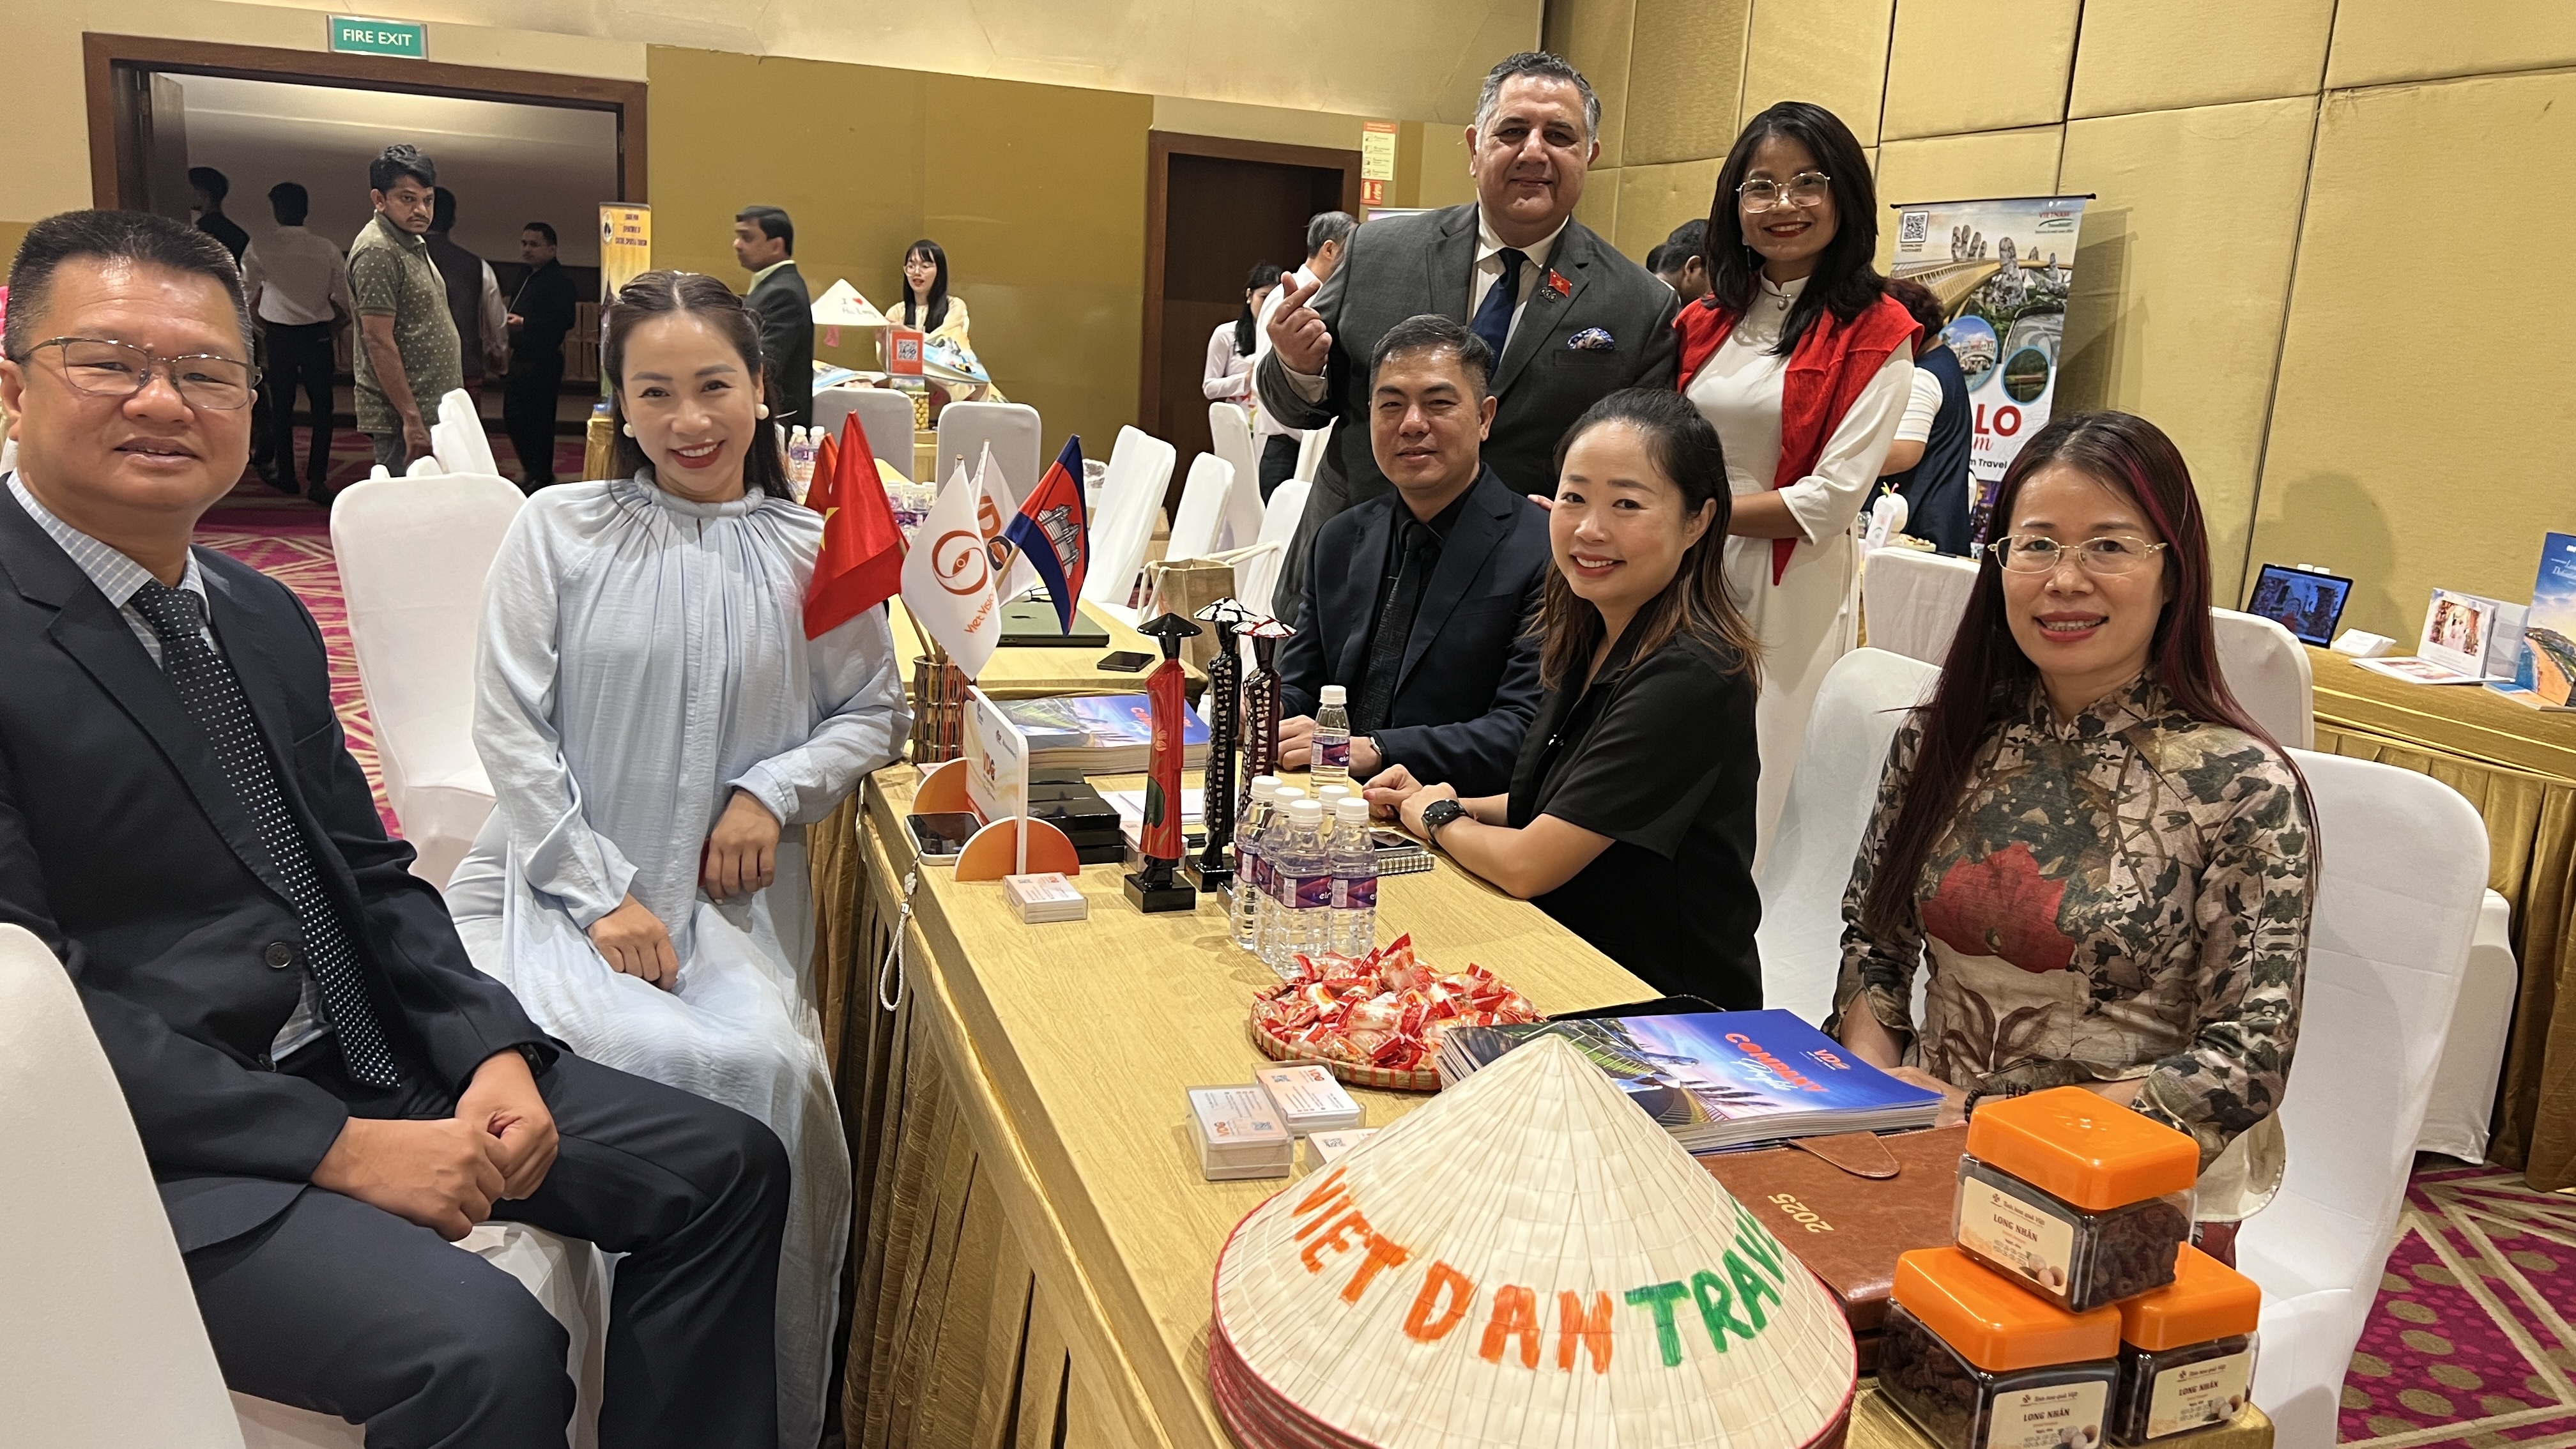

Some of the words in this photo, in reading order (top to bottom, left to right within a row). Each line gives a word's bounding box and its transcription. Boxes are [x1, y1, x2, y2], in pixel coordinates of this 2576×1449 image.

[343, 29, 374, 43] FIRE
[378, 31, 413, 46] EXIT
[1974, 403, 2021, 437] LO
[1979, 458, 2007, 469] Travel
[963, 615, 985, 633] Viet
[1725, 1033, 1830, 1092] COMPANY
[1767, 1193, 1834, 1232] 2025
[1993, 1214, 2013, 1229] LONG
[1291, 1165, 1414, 1307] VIET
[1403, 1259, 1613, 1374] DAN
[2179, 1386, 2198, 1396] LONG
[2023, 1412, 2044, 1422] LONG
